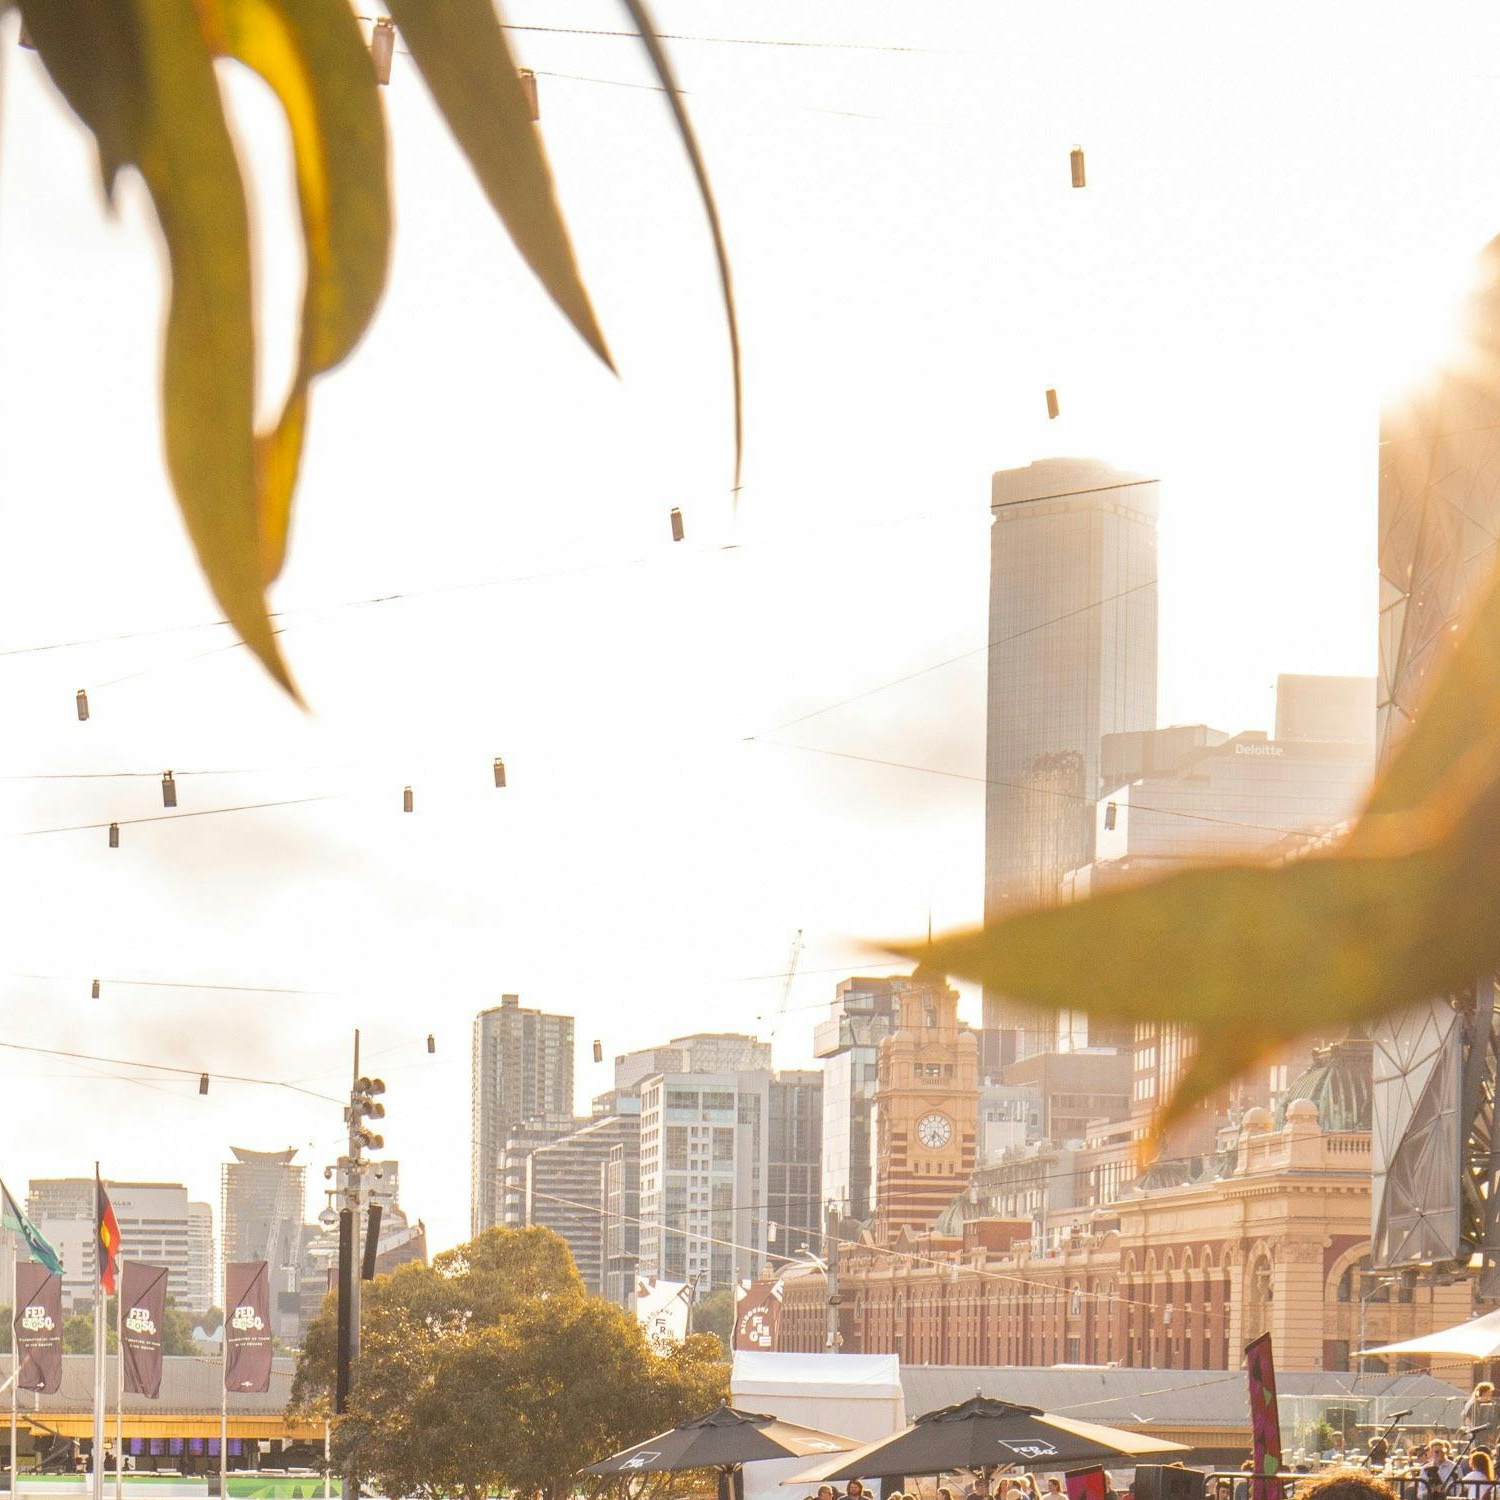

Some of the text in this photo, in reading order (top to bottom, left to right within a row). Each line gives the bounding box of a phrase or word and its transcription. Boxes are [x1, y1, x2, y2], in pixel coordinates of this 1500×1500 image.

[1236, 744, 1284, 755] Deloitte
[25, 1306, 45, 1319] FED
[130, 1307, 149, 1321] FED
[235, 1306, 254, 1319] FED
